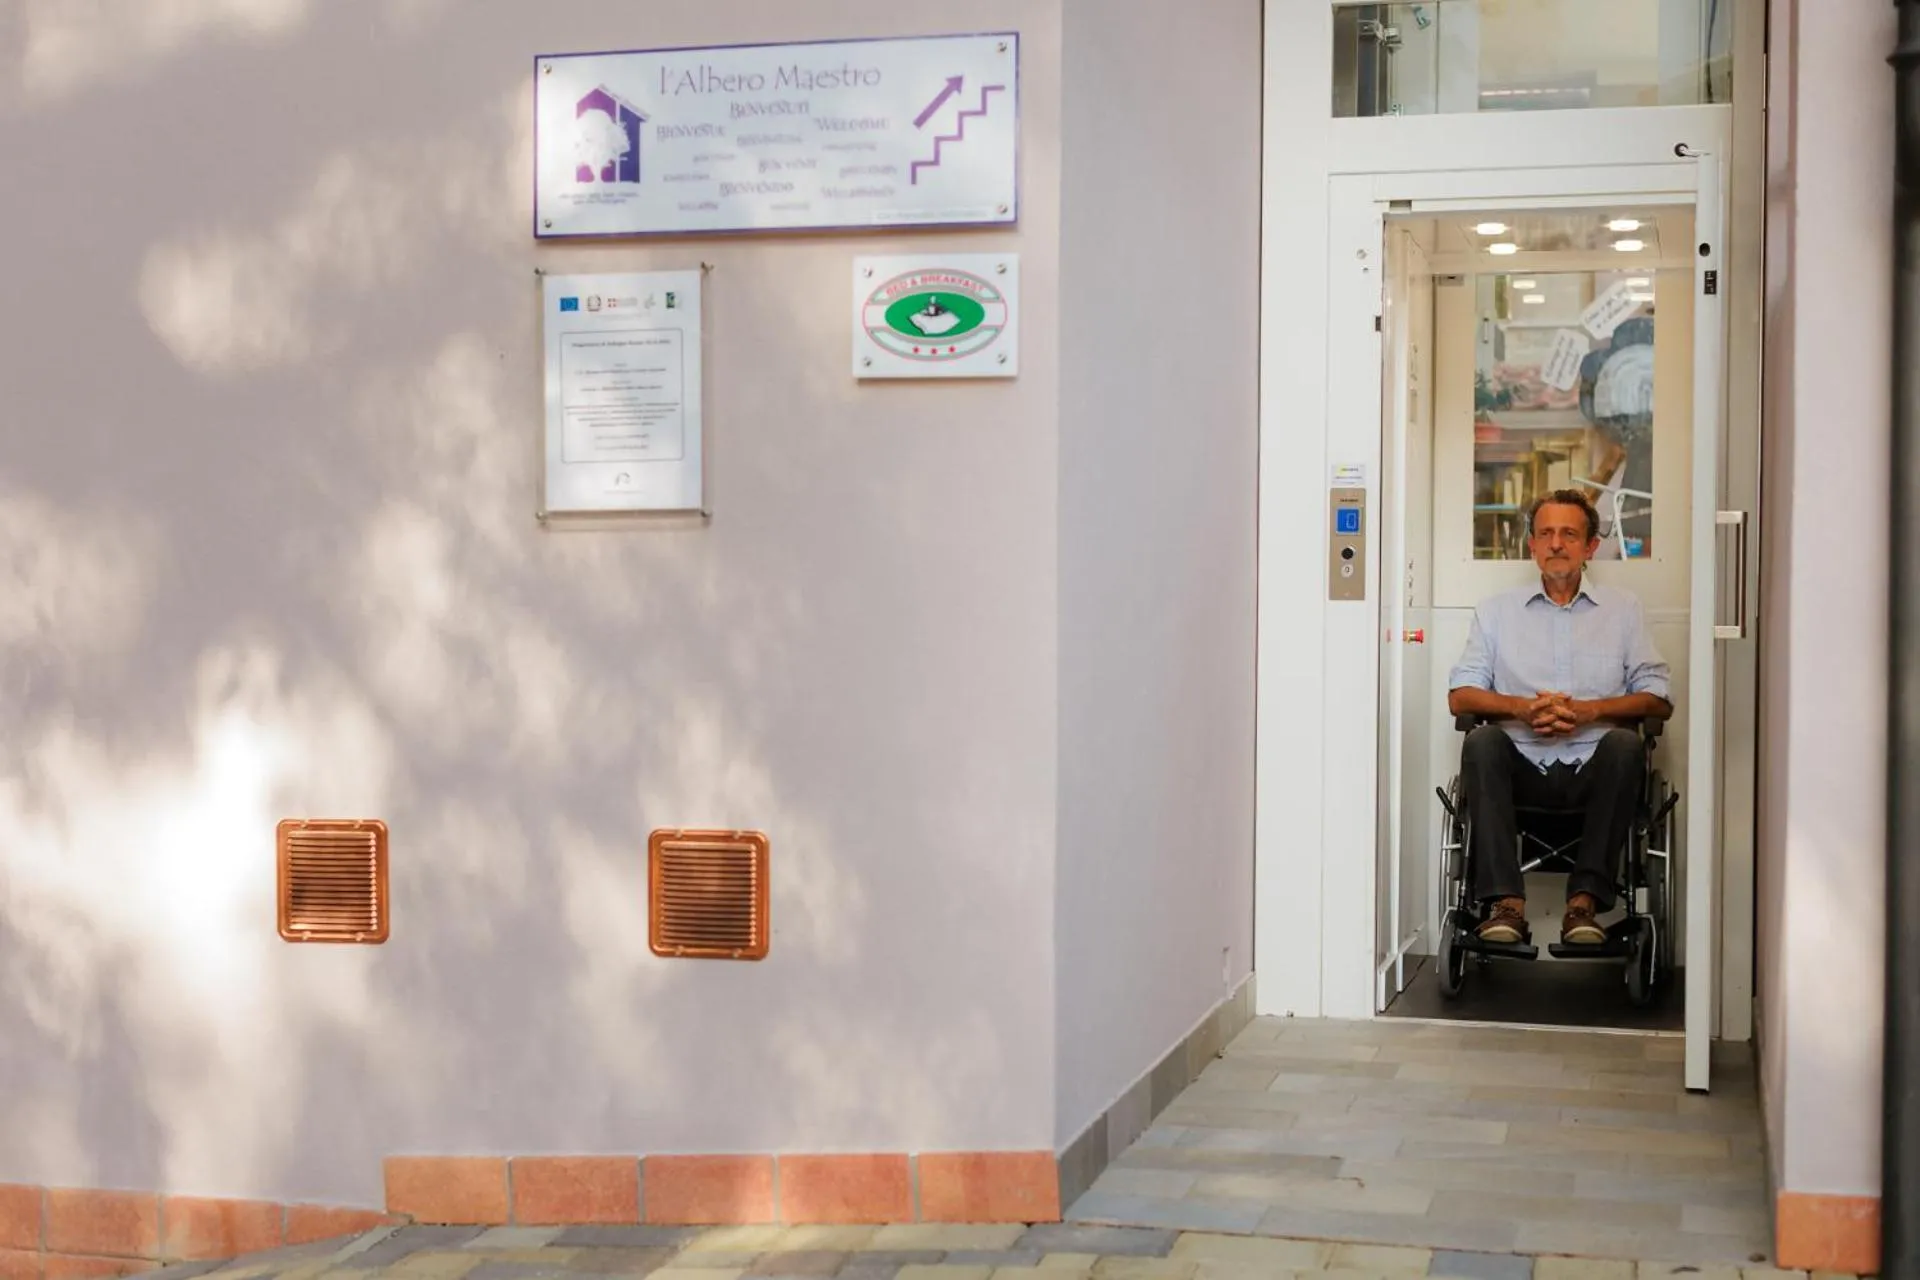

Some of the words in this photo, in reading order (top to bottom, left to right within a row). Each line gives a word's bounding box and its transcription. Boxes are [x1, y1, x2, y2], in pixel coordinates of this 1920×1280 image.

[660, 64, 765, 96] l'Albero
[775, 63, 881, 91] Maestro
[920, 274, 985, 292] BREAKFAST
